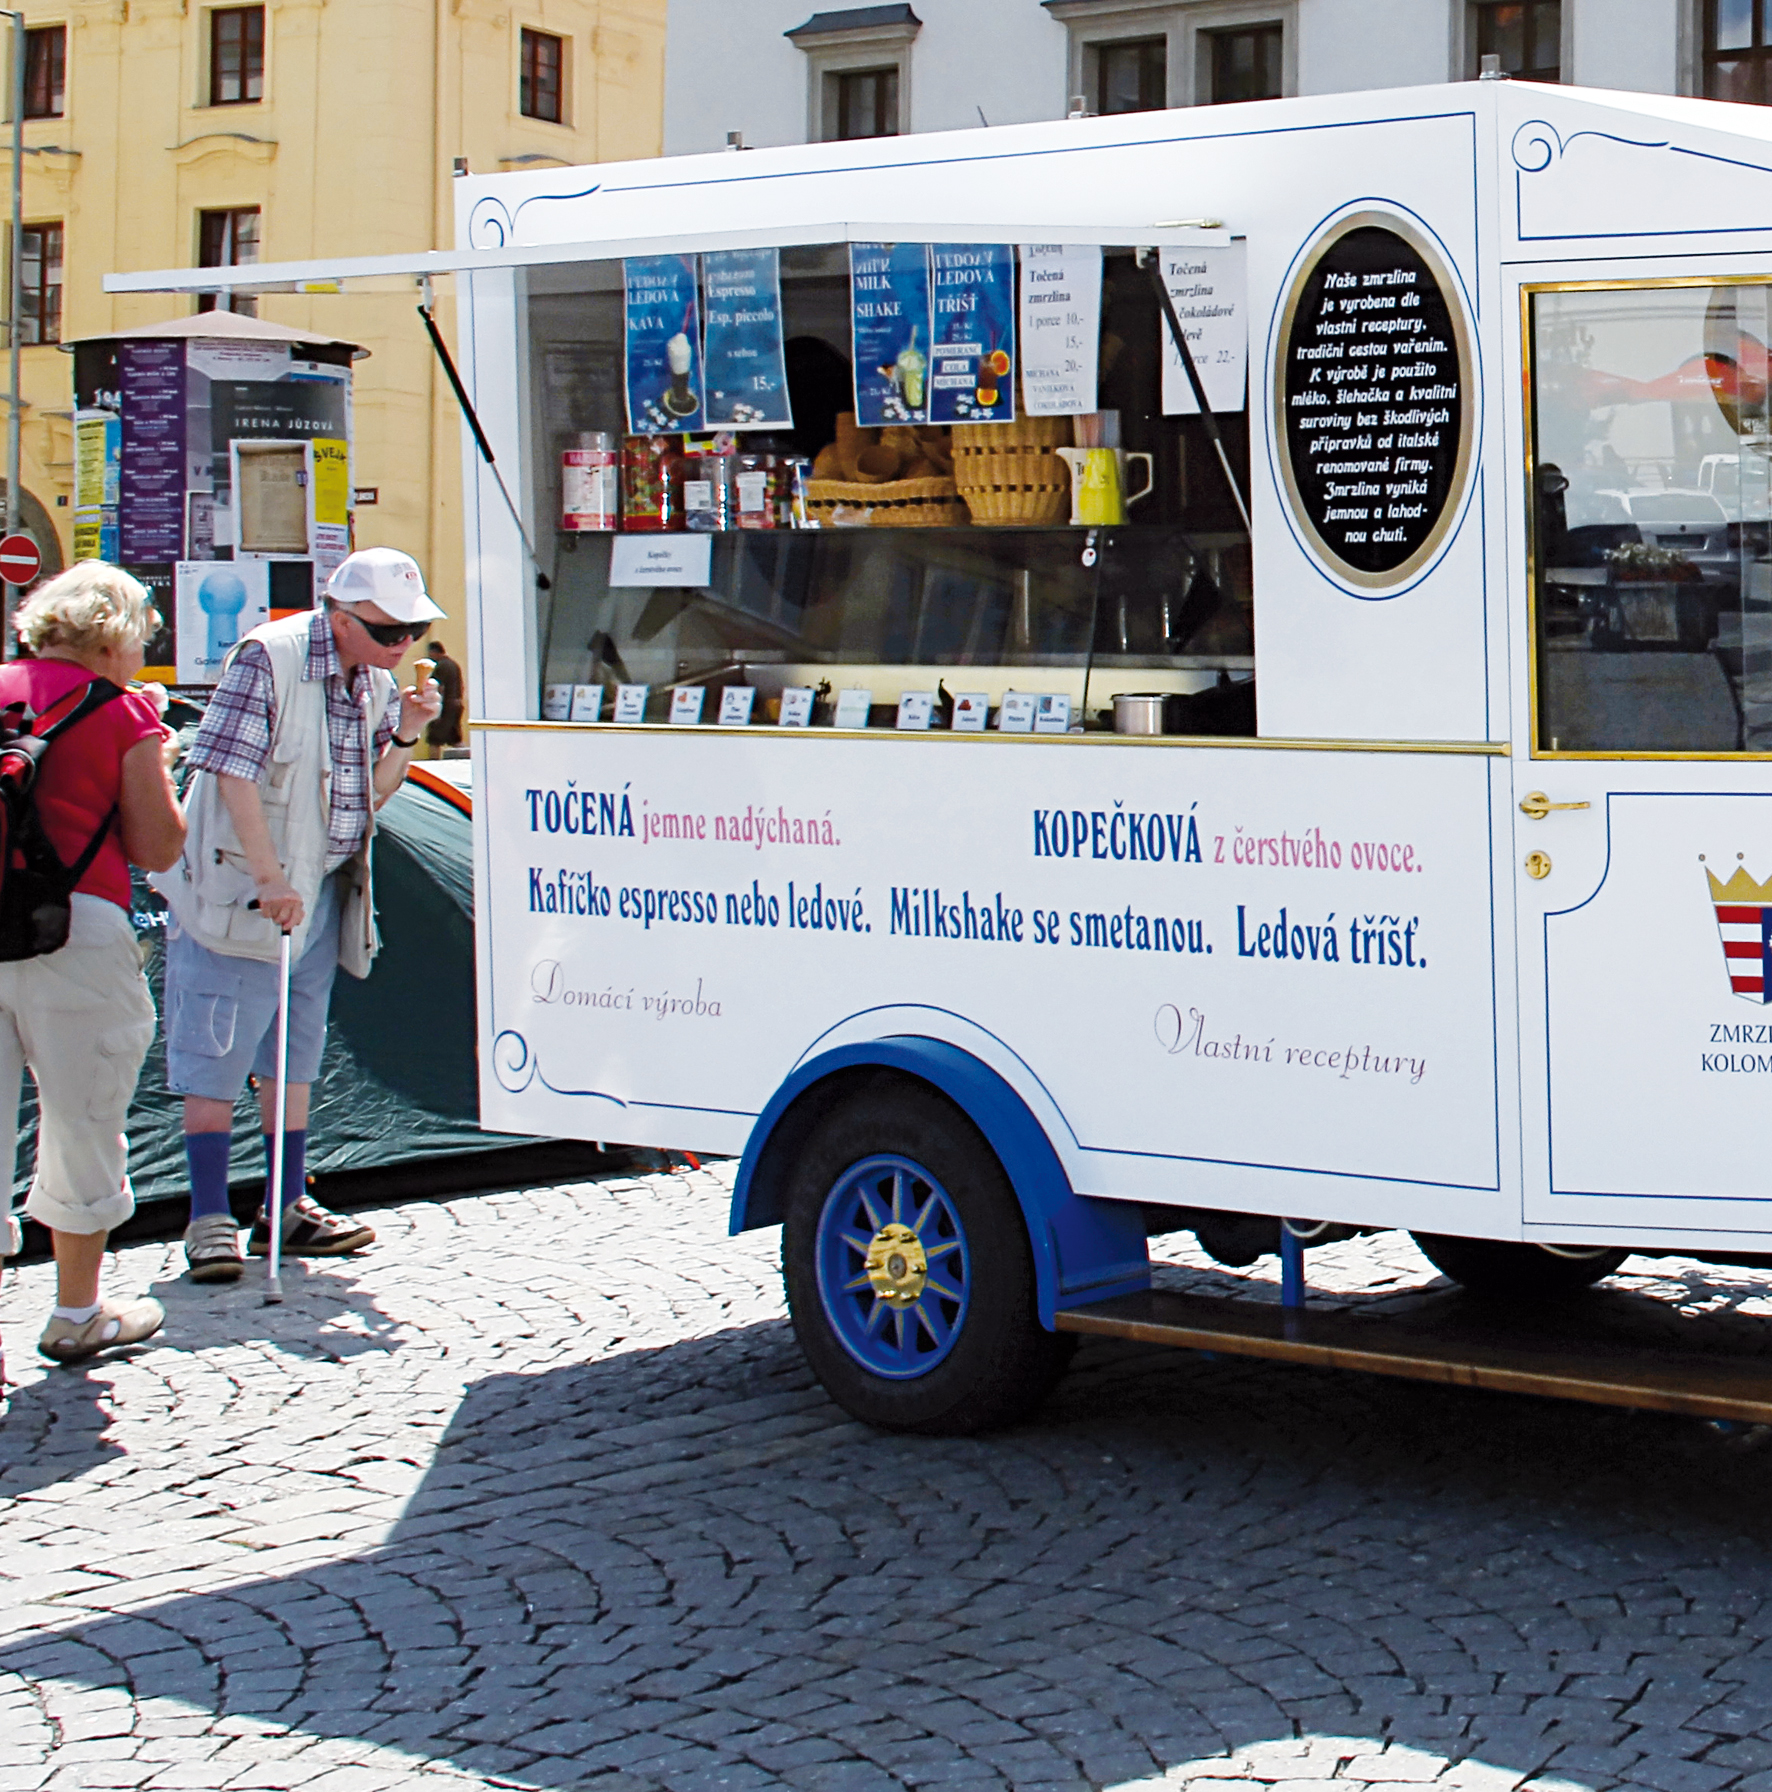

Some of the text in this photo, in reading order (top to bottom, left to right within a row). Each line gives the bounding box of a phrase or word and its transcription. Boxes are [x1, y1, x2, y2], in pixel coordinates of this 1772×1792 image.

[1029, 269, 1064, 283] Točená
[1169, 261, 1207, 276] Točená
[856, 275, 892, 291] MILK
[1324, 269, 1416, 289] Naše zmrzlina
[1028, 292, 1071, 304] zmrzlina
[1169, 285, 1214, 299] zmrzlina
[856, 301, 903, 318] SHAKE
[1178, 303, 1235, 319] čokoládové
[1320, 292, 1420, 315] je vyrobena dle
[735, 308, 775, 326] piccolo
[1036, 315, 1061, 329] porce
[1349, 343, 1387, 357] cestou
[1309, 362, 1436, 384] K výrobě je použito
[1336, 388, 1390, 404] šlehačka
[1395, 391, 1404, 401] a
[235, 418, 280, 429] IRENA
[1299, 408, 1449, 430] suroviny bez škodlivých
[1310, 431, 1439, 454] přípravků od italské
[1316, 456, 1433, 474] renomované firmy.
[1324, 479, 1428, 500] Zmrzlina vyniká
[1323, 503, 1428, 524] jemnou a lahod-
[1345, 529, 1366, 543] nou
[526, 779, 841, 850] TOČENÁ jemne nadýchaná.
[1033, 799, 1423, 873] KOPEČKOVÁ z čerstvého ovoce.
[529, 867, 1427, 969] Kafíčko espresso nebo ledové. Milkshake se smetanou. Ledová tříšť.
[531, 959, 722, 1021] Domácí výroba
[1154, 1003, 1427, 1085] Vlastní receptury
